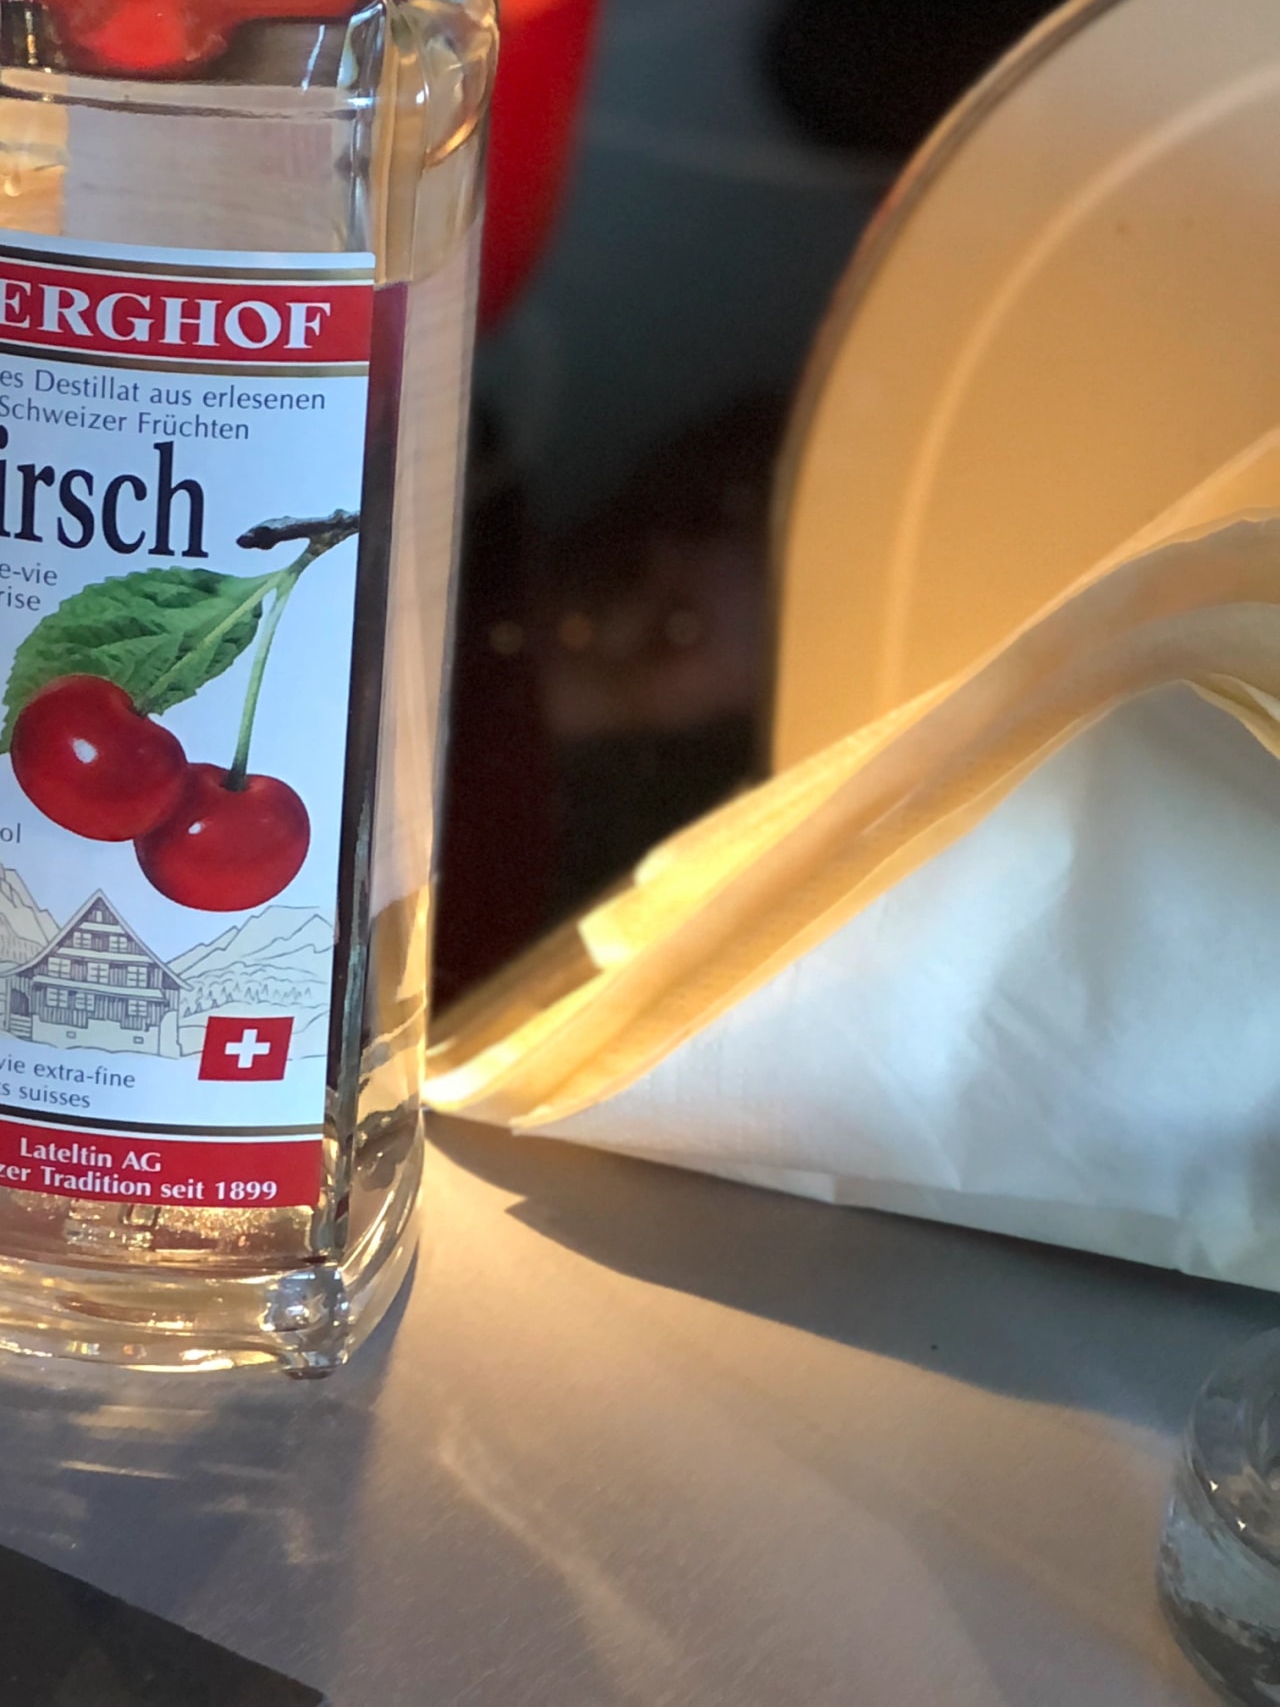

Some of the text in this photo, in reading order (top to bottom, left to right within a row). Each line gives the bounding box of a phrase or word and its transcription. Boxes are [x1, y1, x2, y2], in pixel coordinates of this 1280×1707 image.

[34, 369, 141, 403] Destillat
[149, 386, 193, 407] aus
[202, 385, 327, 411] erlesenen
[137, 413, 250, 441] Früchten
[33, 1061, 137, 1089] extra-fine
[19, 1083, 91, 1109] suisses
[20, 1137, 162, 1174] Lateltin AG
[41, 1166, 152, 1199] Tradition
[160, 1180, 205, 1200] seit
[214, 1180, 279, 1201] 1899
